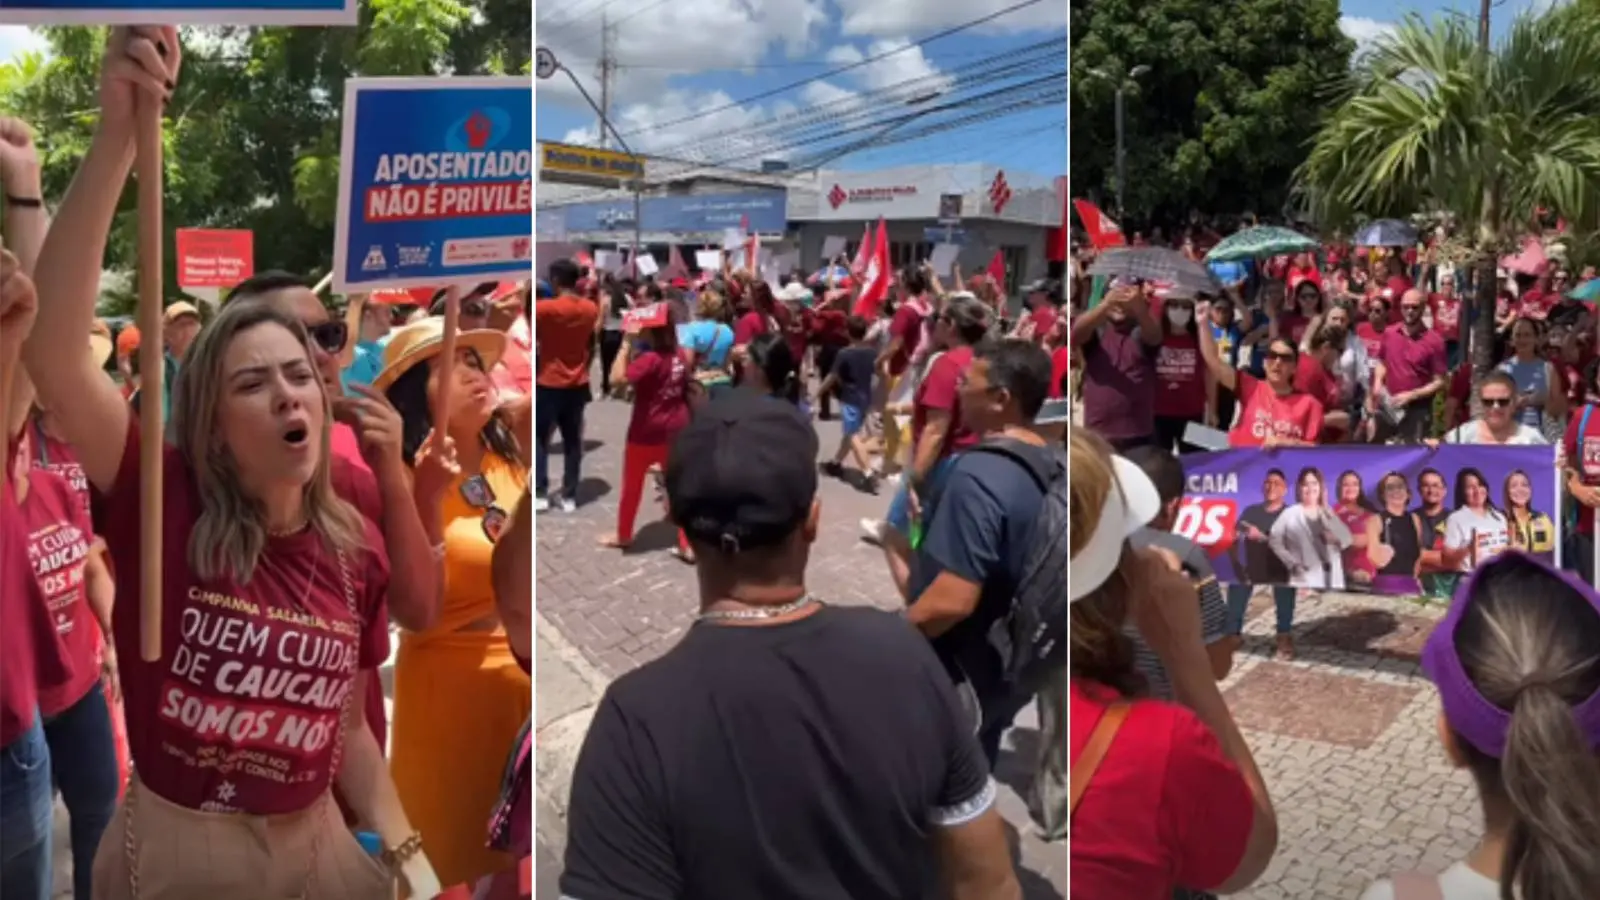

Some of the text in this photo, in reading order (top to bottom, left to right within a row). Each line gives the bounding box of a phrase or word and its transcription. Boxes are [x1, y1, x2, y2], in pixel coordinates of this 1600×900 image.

[374, 150, 532, 182] APOSENTADO
[369, 178, 532, 217] NÃO É PRIVILÉ
[1184, 472, 1238, 493] CAIA
[180, 607, 356, 673] QUEM CUIDA
[170, 644, 347, 709] DE CAUCAIA
[161, 688, 275, 742] SOMOS
